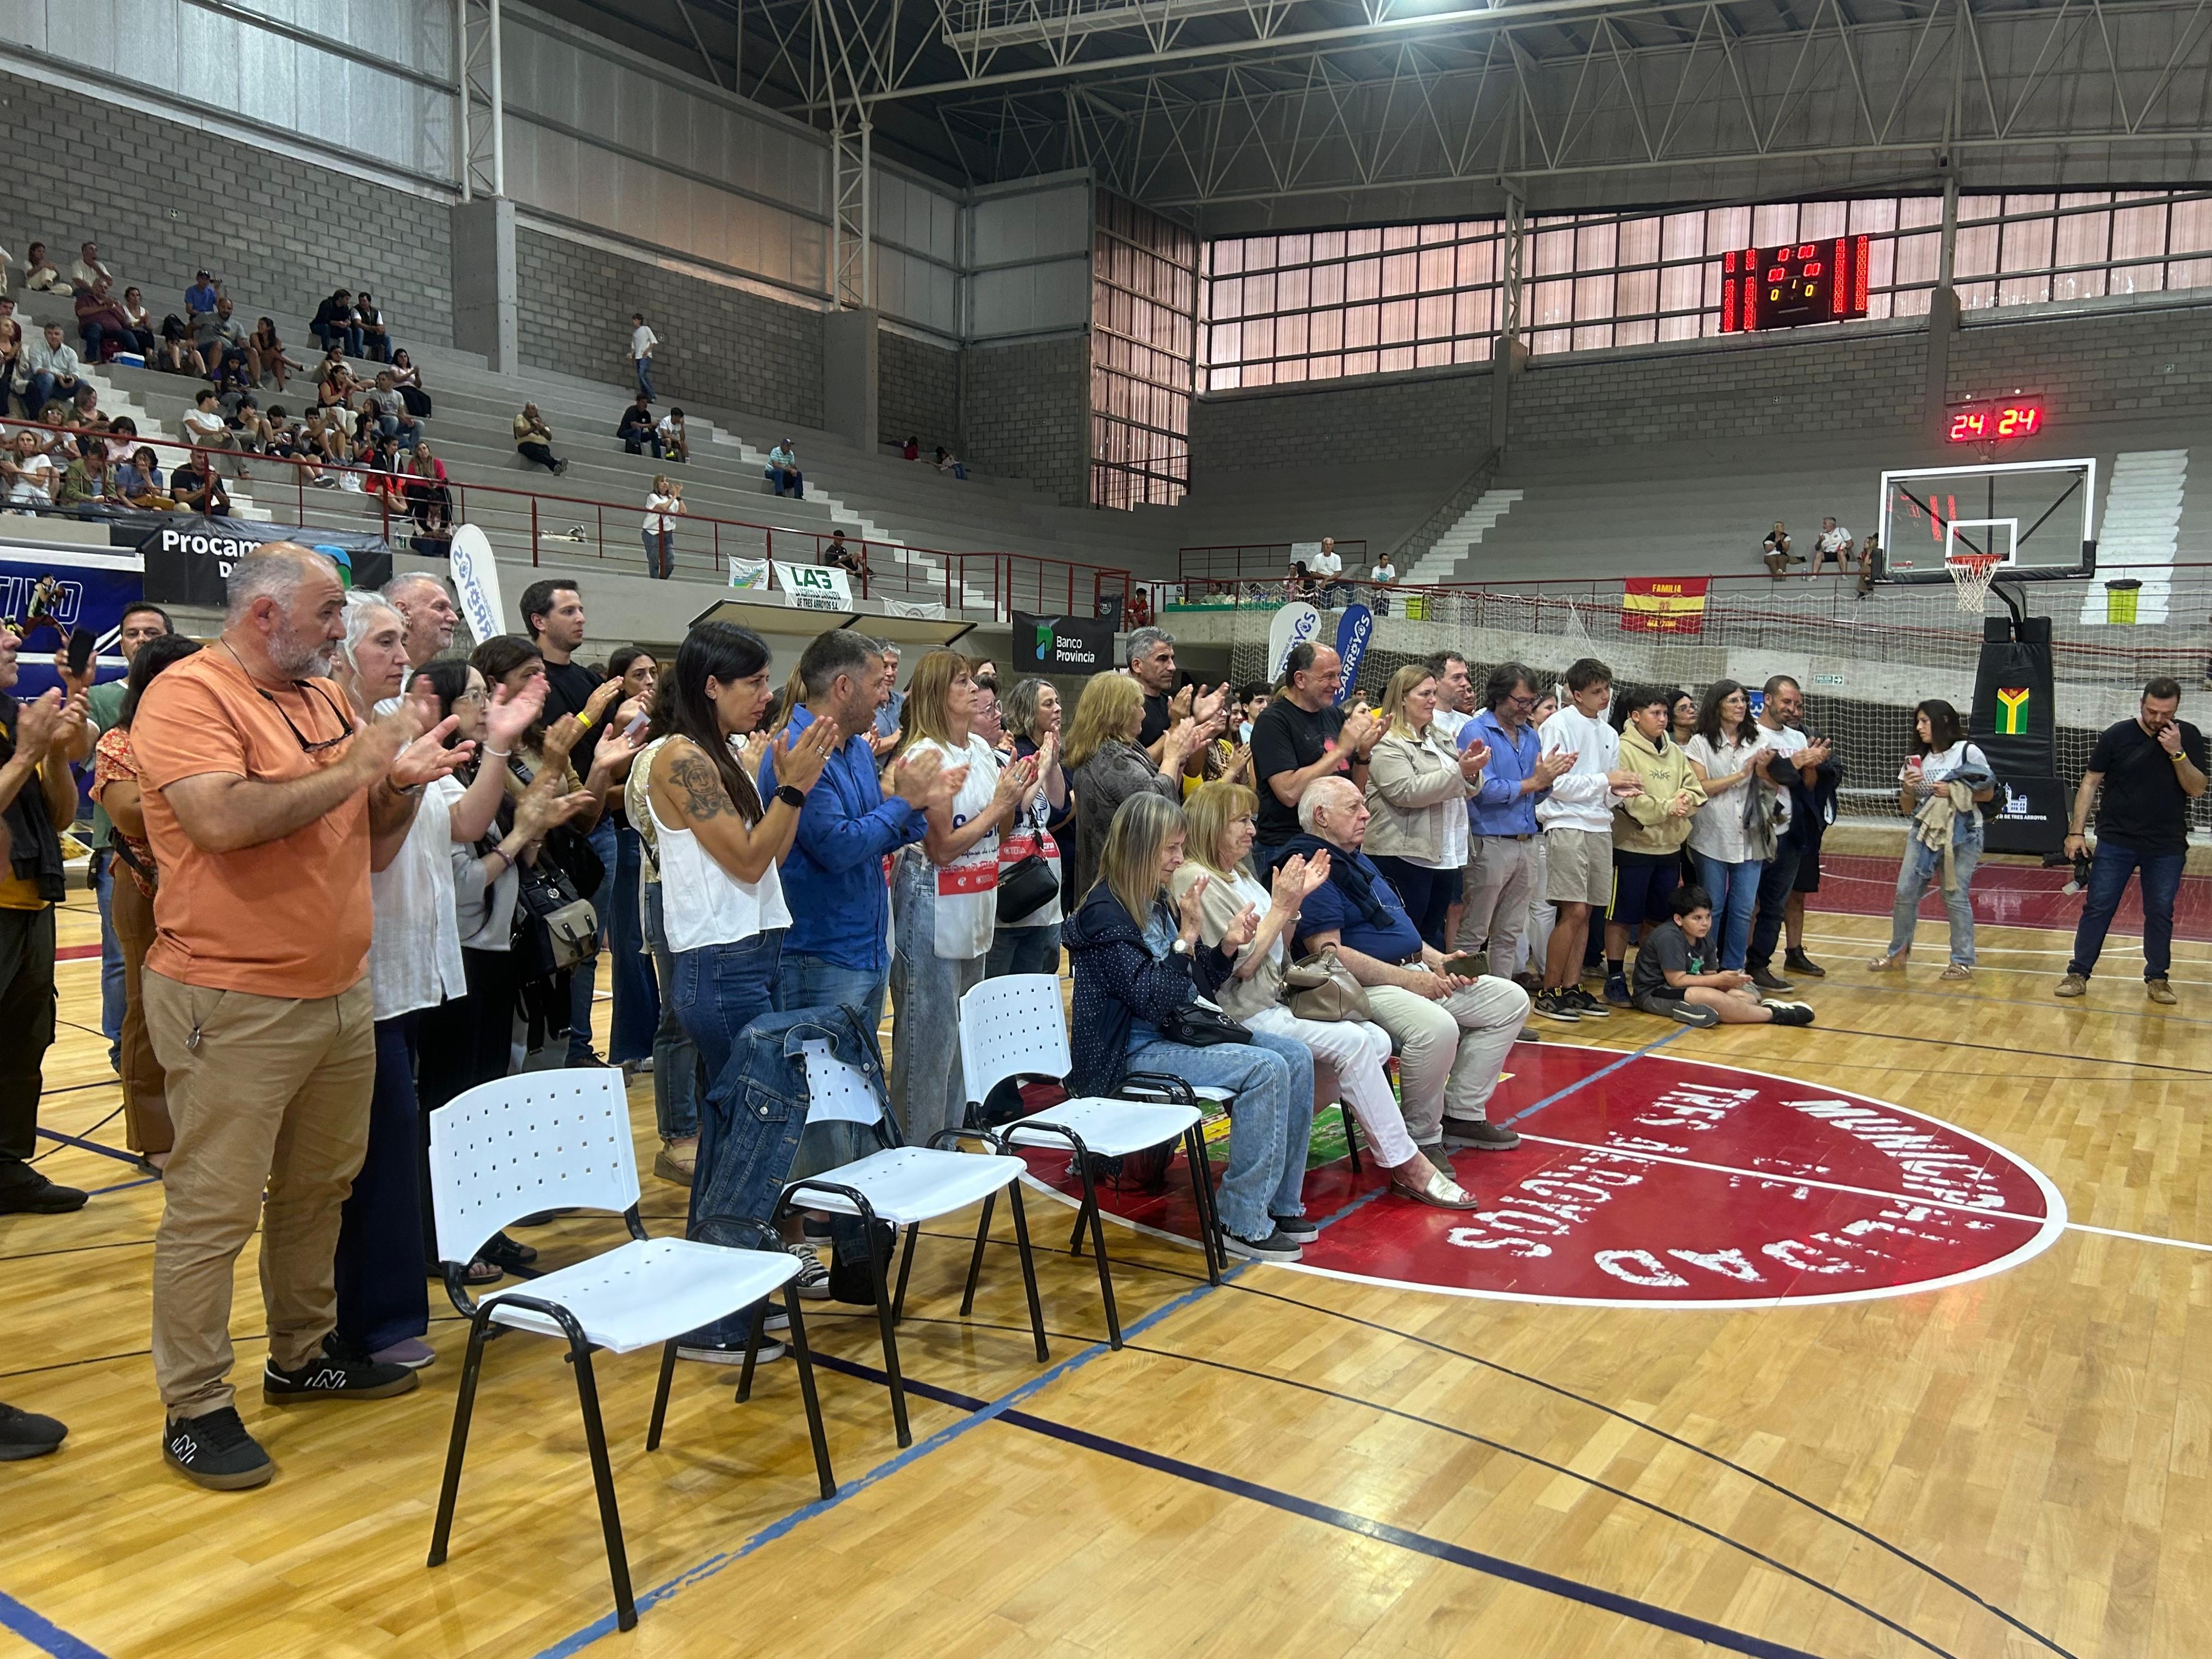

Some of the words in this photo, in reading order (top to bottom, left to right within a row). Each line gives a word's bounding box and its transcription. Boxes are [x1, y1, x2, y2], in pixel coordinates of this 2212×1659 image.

[1951, 414, 1984, 438] 24
[1999, 409, 2035, 434] 24
[163, 530, 262, 557] Procam
[1652, 584, 1681, 594] FAMILIA
[797, 597, 802, 607] DE
[803, 599, 812, 608] TRES
[814, 599, 831, 610] ARROYOS
[1057, 636, 1082, 648] Banco
[1056, 650, 1095, 663] Provincia
